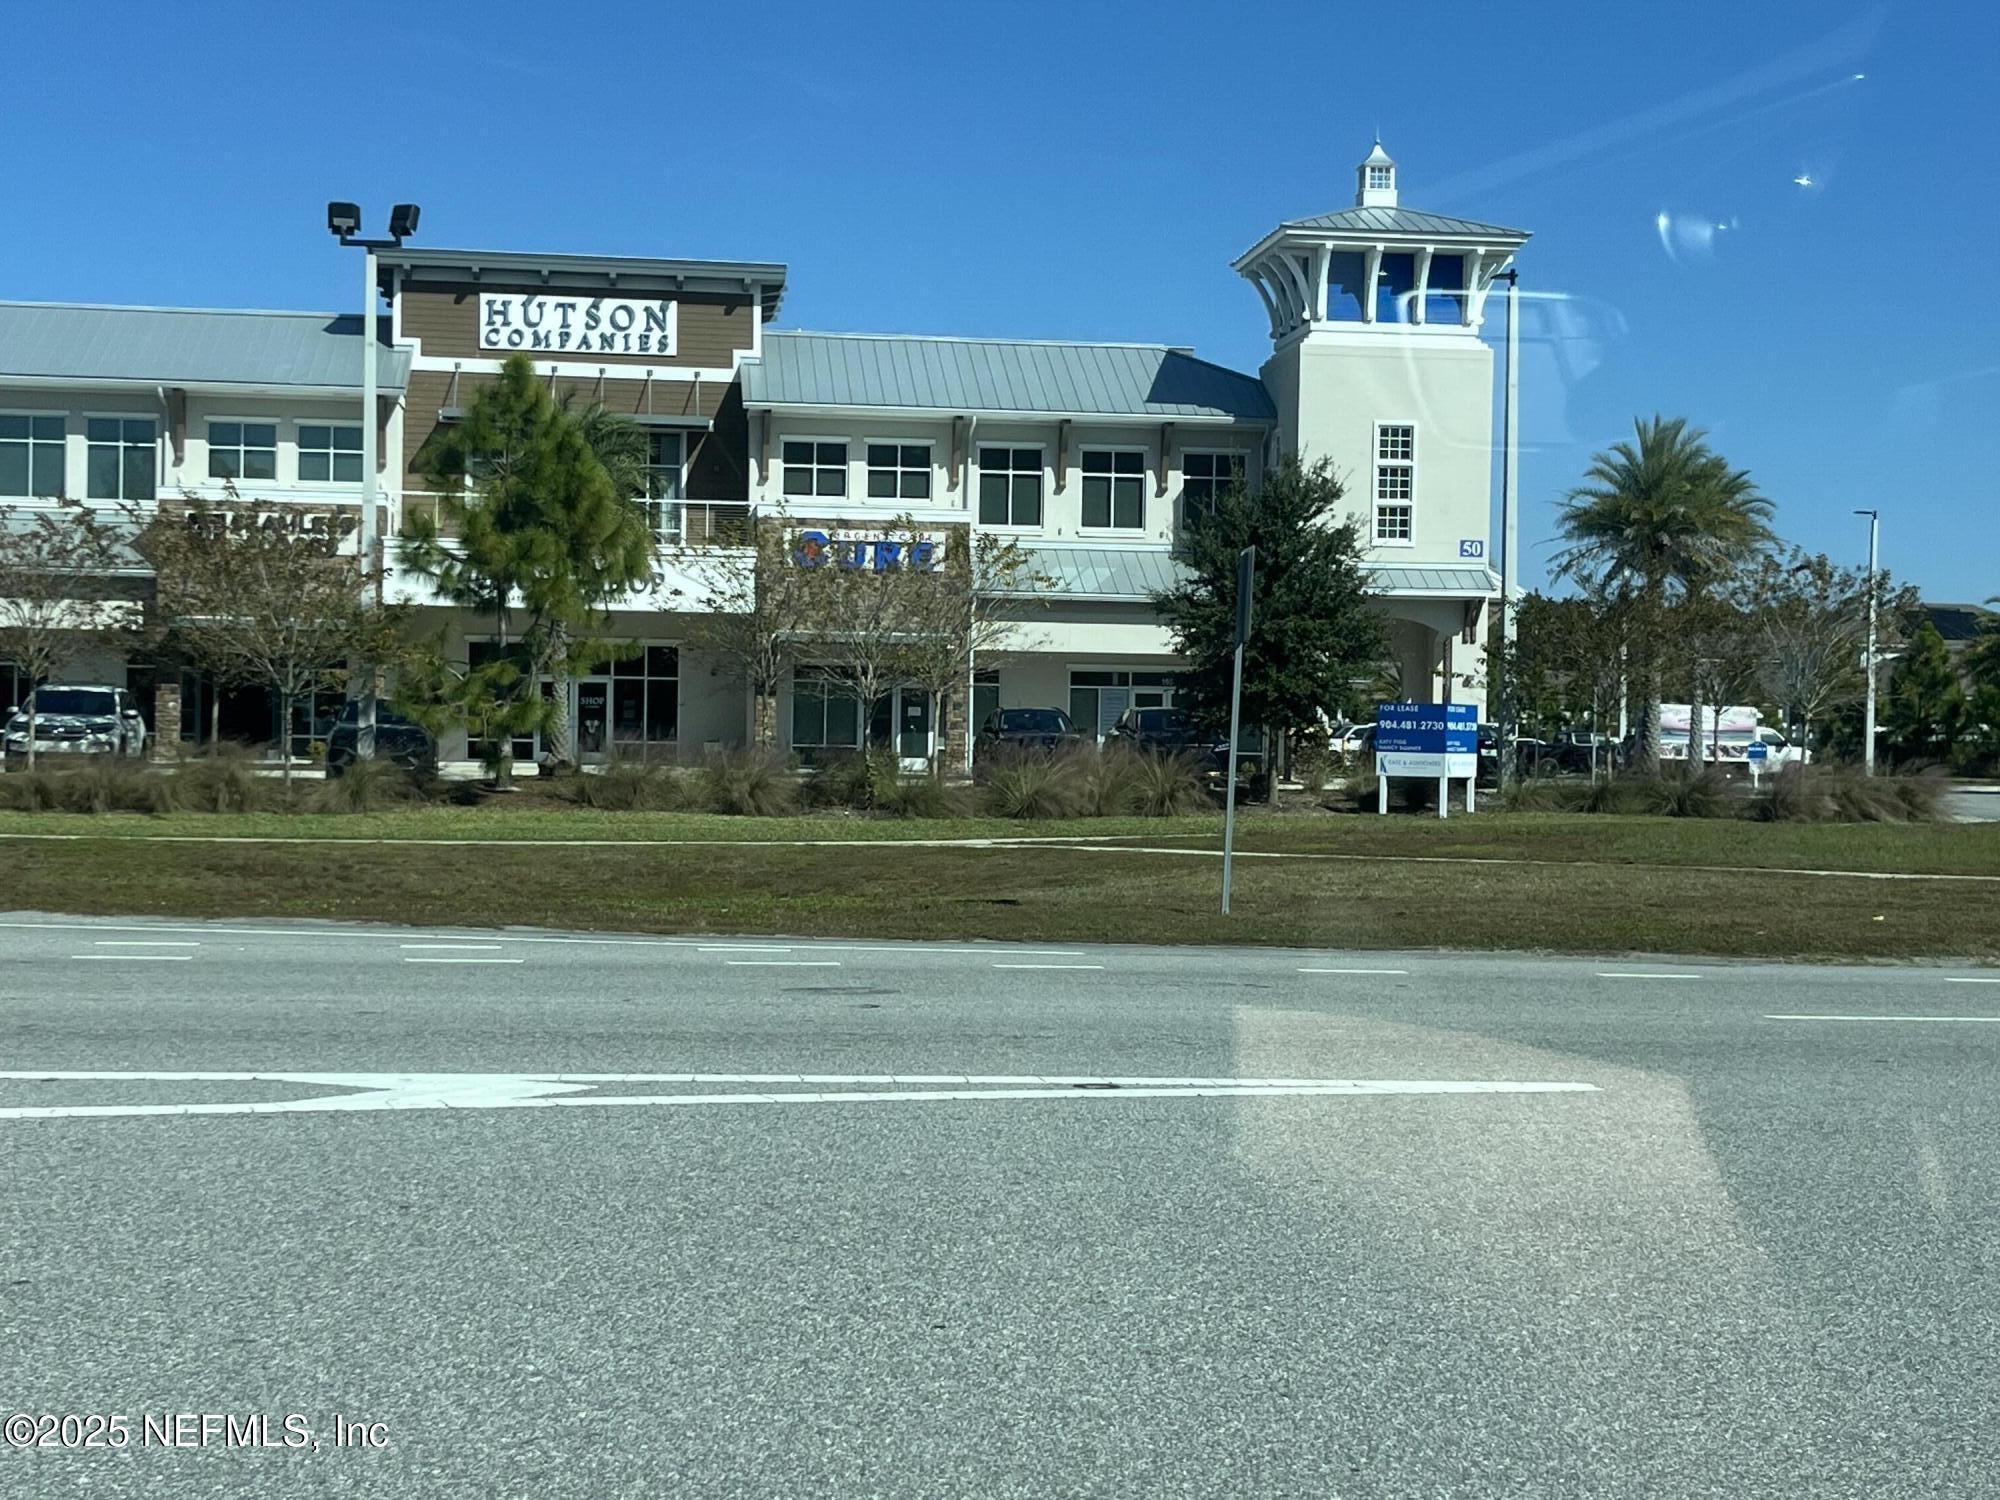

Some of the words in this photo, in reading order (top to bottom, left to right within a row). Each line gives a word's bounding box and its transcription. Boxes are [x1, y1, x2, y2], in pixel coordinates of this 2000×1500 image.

[485, 299, 670, 333] HUTSON
[485, 328, 669, 353] COMPANIES
[1462, 541, 1481, 556] 50
[580, 696, 605, 705] SHOP
[1397, 704, 1419, 712] LEASE
[1379, 720, 1444, 730] 904.481.2730
